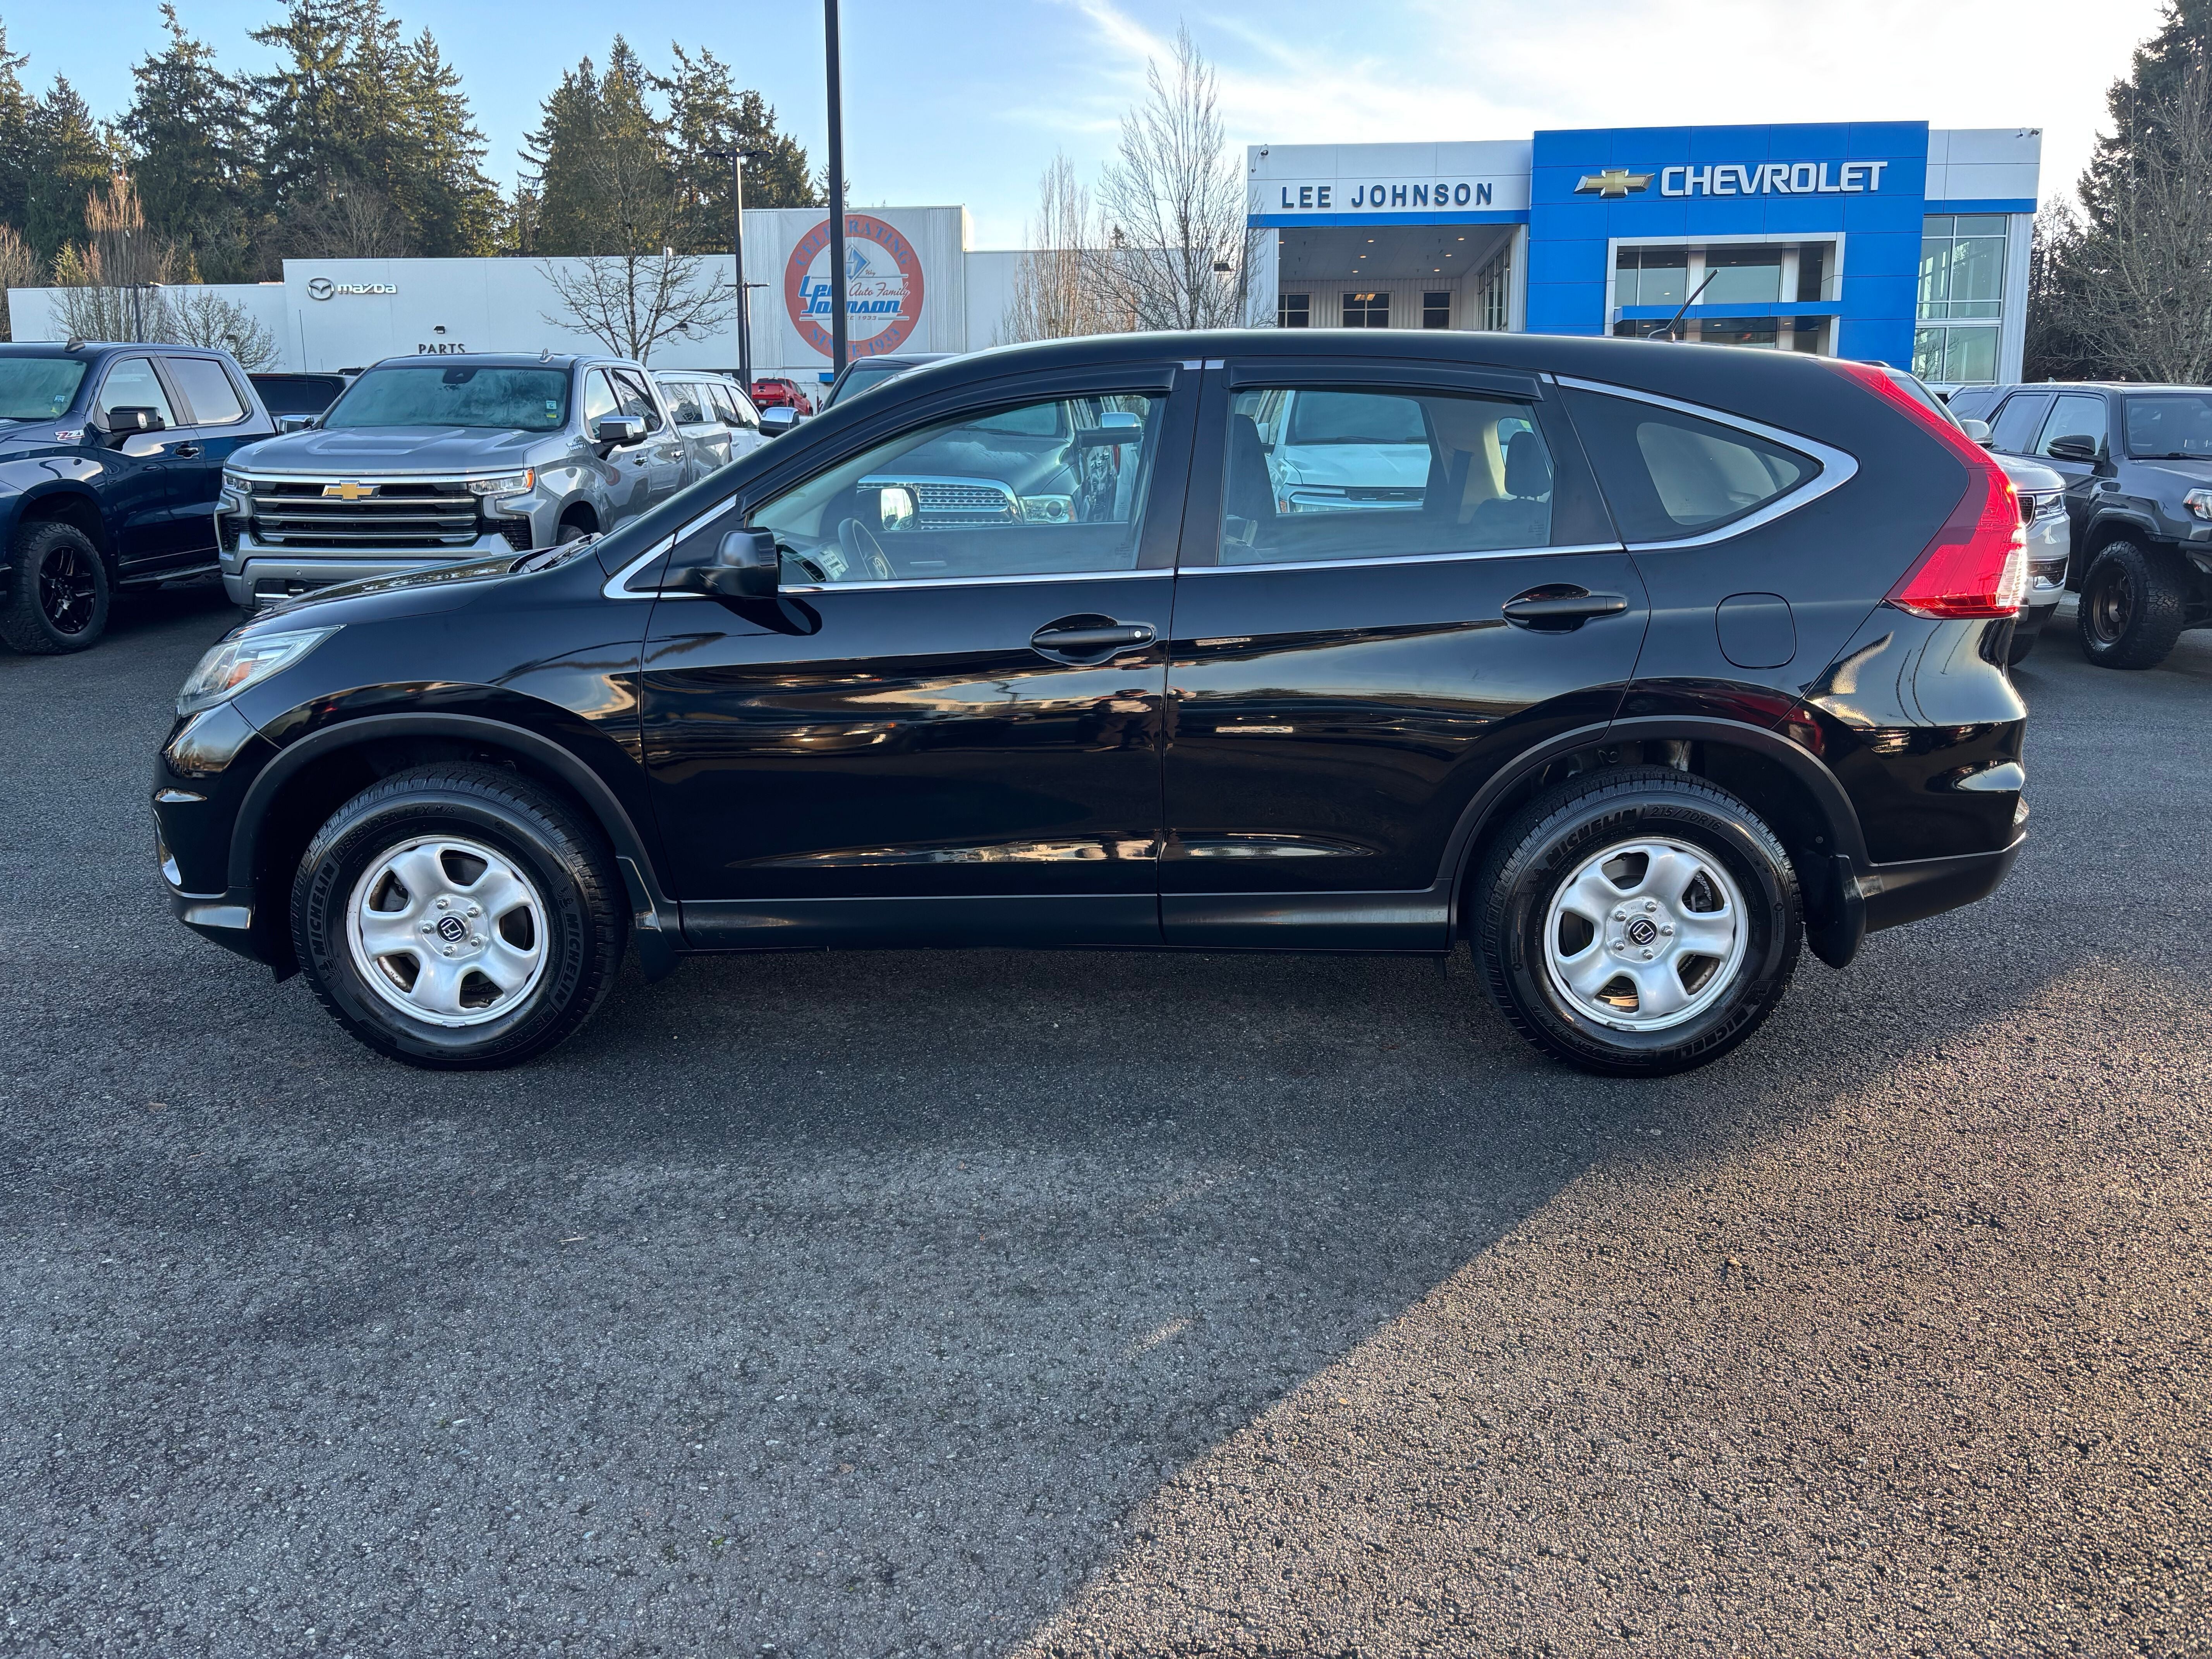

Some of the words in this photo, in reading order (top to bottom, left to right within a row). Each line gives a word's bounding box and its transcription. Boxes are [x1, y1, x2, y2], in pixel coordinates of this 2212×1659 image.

[1661, 161, 1888, 196] CHEVROLET
[1282, 186, 1331, 208] LEE
[1351, 183, 1492, 208] JOHNSON
[849, 282, 874, 296] Auto
[876, 282, 910, 302] Family
[418, 343, 465, 354] PARTS
[868, 327, 900, 355] 1933
[1650, 805, 1723, 830] 215/70R16
[1545, 808, 1638, 867] MICHELIN
[310, 861, 335, 956] MICHELIN
[554, 913, 580, 1006] MICHELIN
